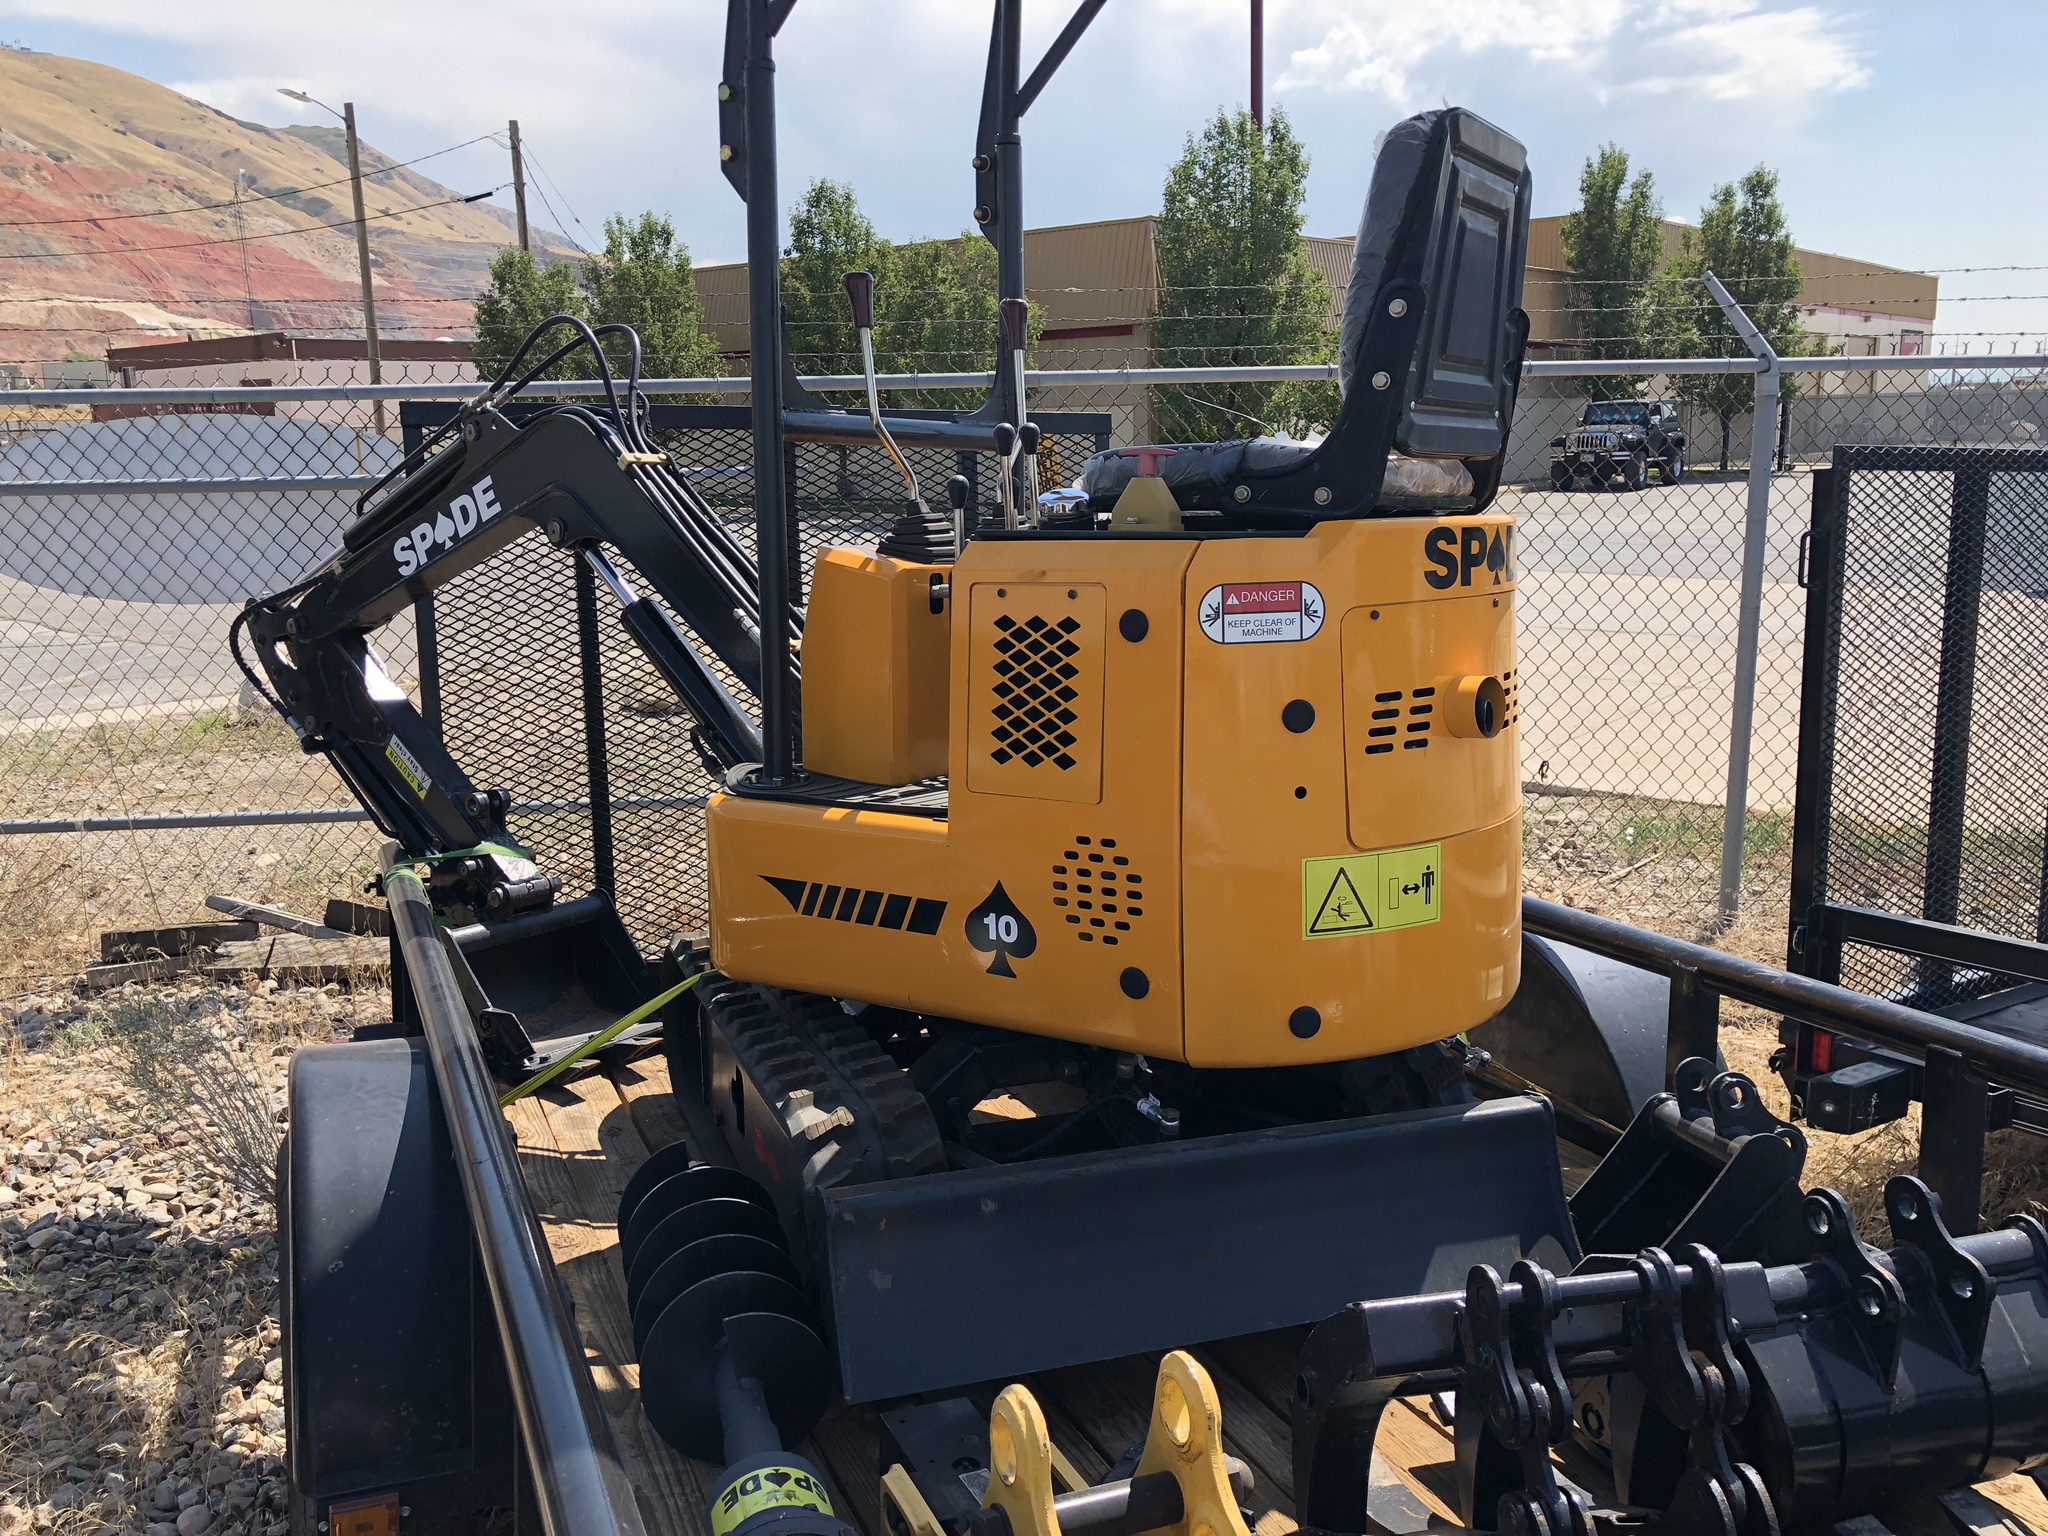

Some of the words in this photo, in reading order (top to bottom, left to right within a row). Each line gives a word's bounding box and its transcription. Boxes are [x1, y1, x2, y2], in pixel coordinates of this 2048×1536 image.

[1241, 590, 1295, 603] DANGER
[1227, 619, 1251, 628] KEEP
[1253, 618, 1283, 627] CLEAR
[1284, 617, 1297, 626] OF
[1242, 627, 1283, 637] MACHINE
[389, 750, 415, 783] CAUTION
[407, 755, 419, 773] Stay
[983, 912, 1018, 943] 10
